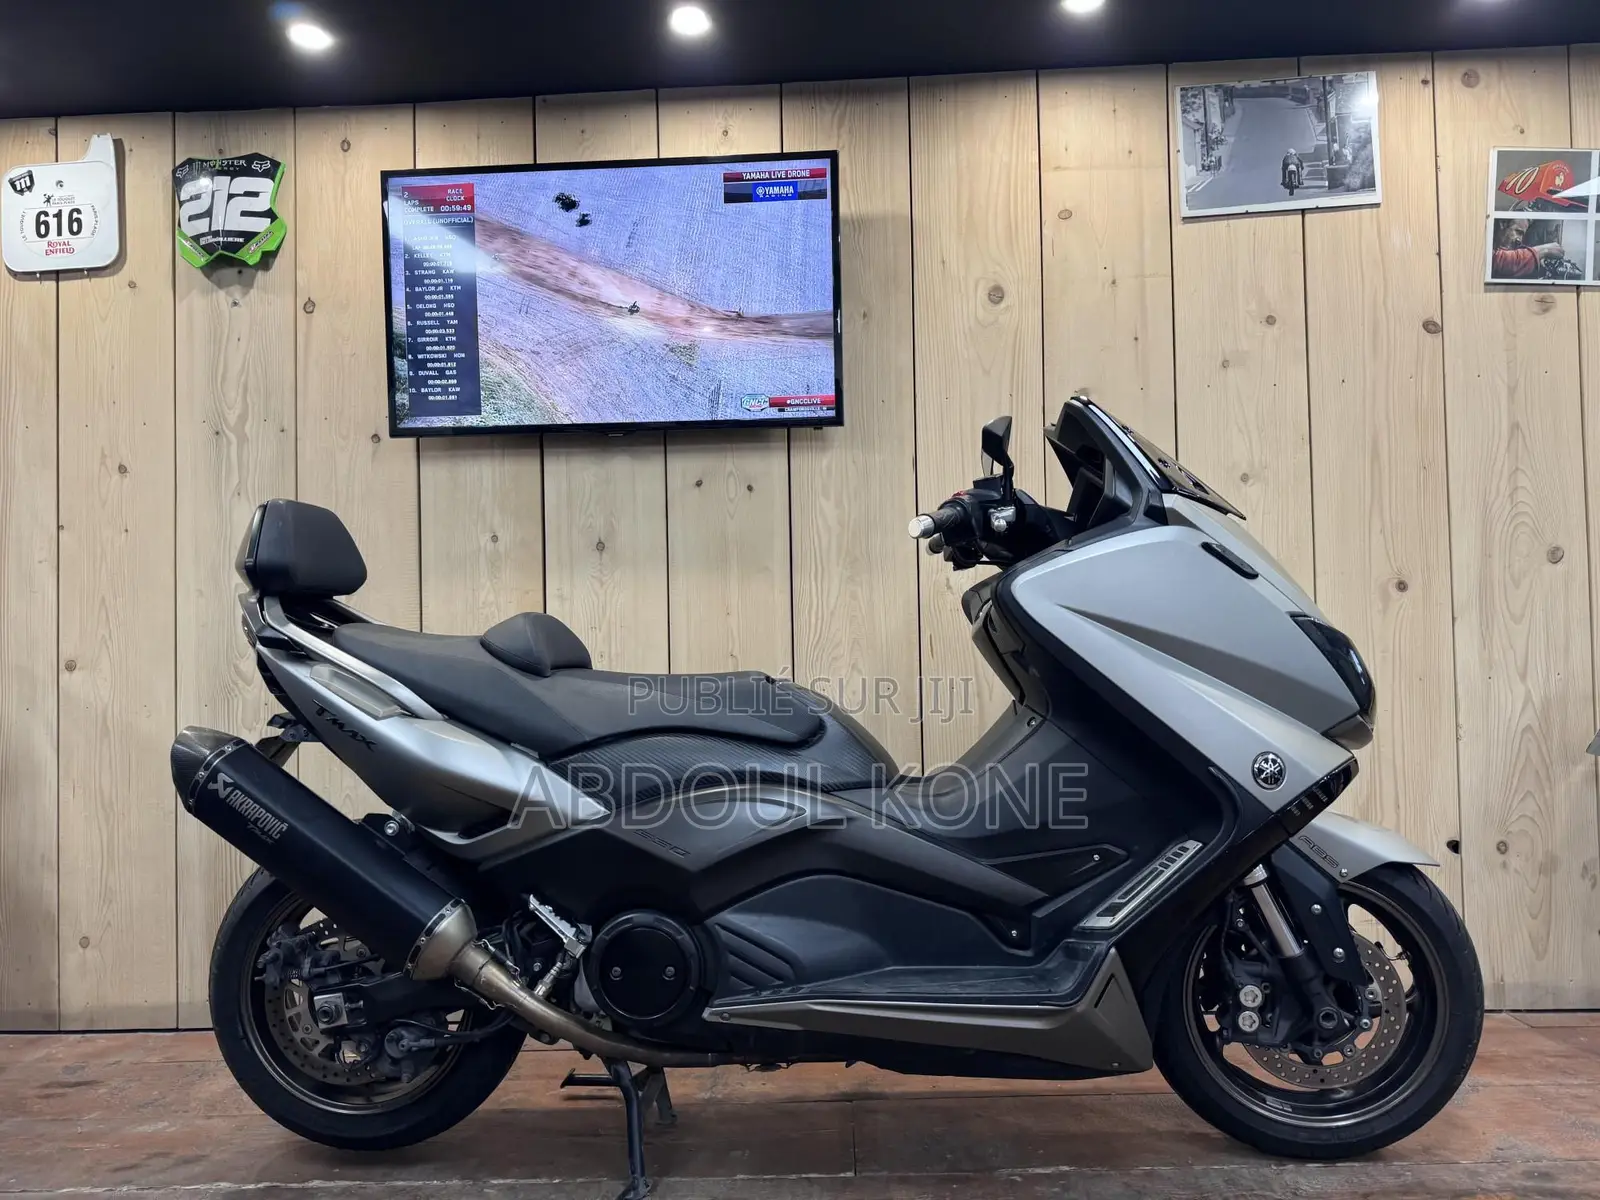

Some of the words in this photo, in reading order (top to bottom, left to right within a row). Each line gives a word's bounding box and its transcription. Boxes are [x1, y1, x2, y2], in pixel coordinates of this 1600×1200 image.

[202, 160, 247, 169] MONSTER
[742, 171, 769, 180] YAMAHA
[771, 170, 786, 179] LIVE
[787, 168, 811, 178] DRONE
[765, 186, 794, 195] YAMAHA
[179, 176, 275, 237] 212
[440, 204, 472, 212] 00:59:49
[35, 208, 83, 239] 616
[47, 241, 72, 249] ROYAL
[45, 247, 75, 256] ENFIELD
[1298, 834, 1339, 869] ABS
